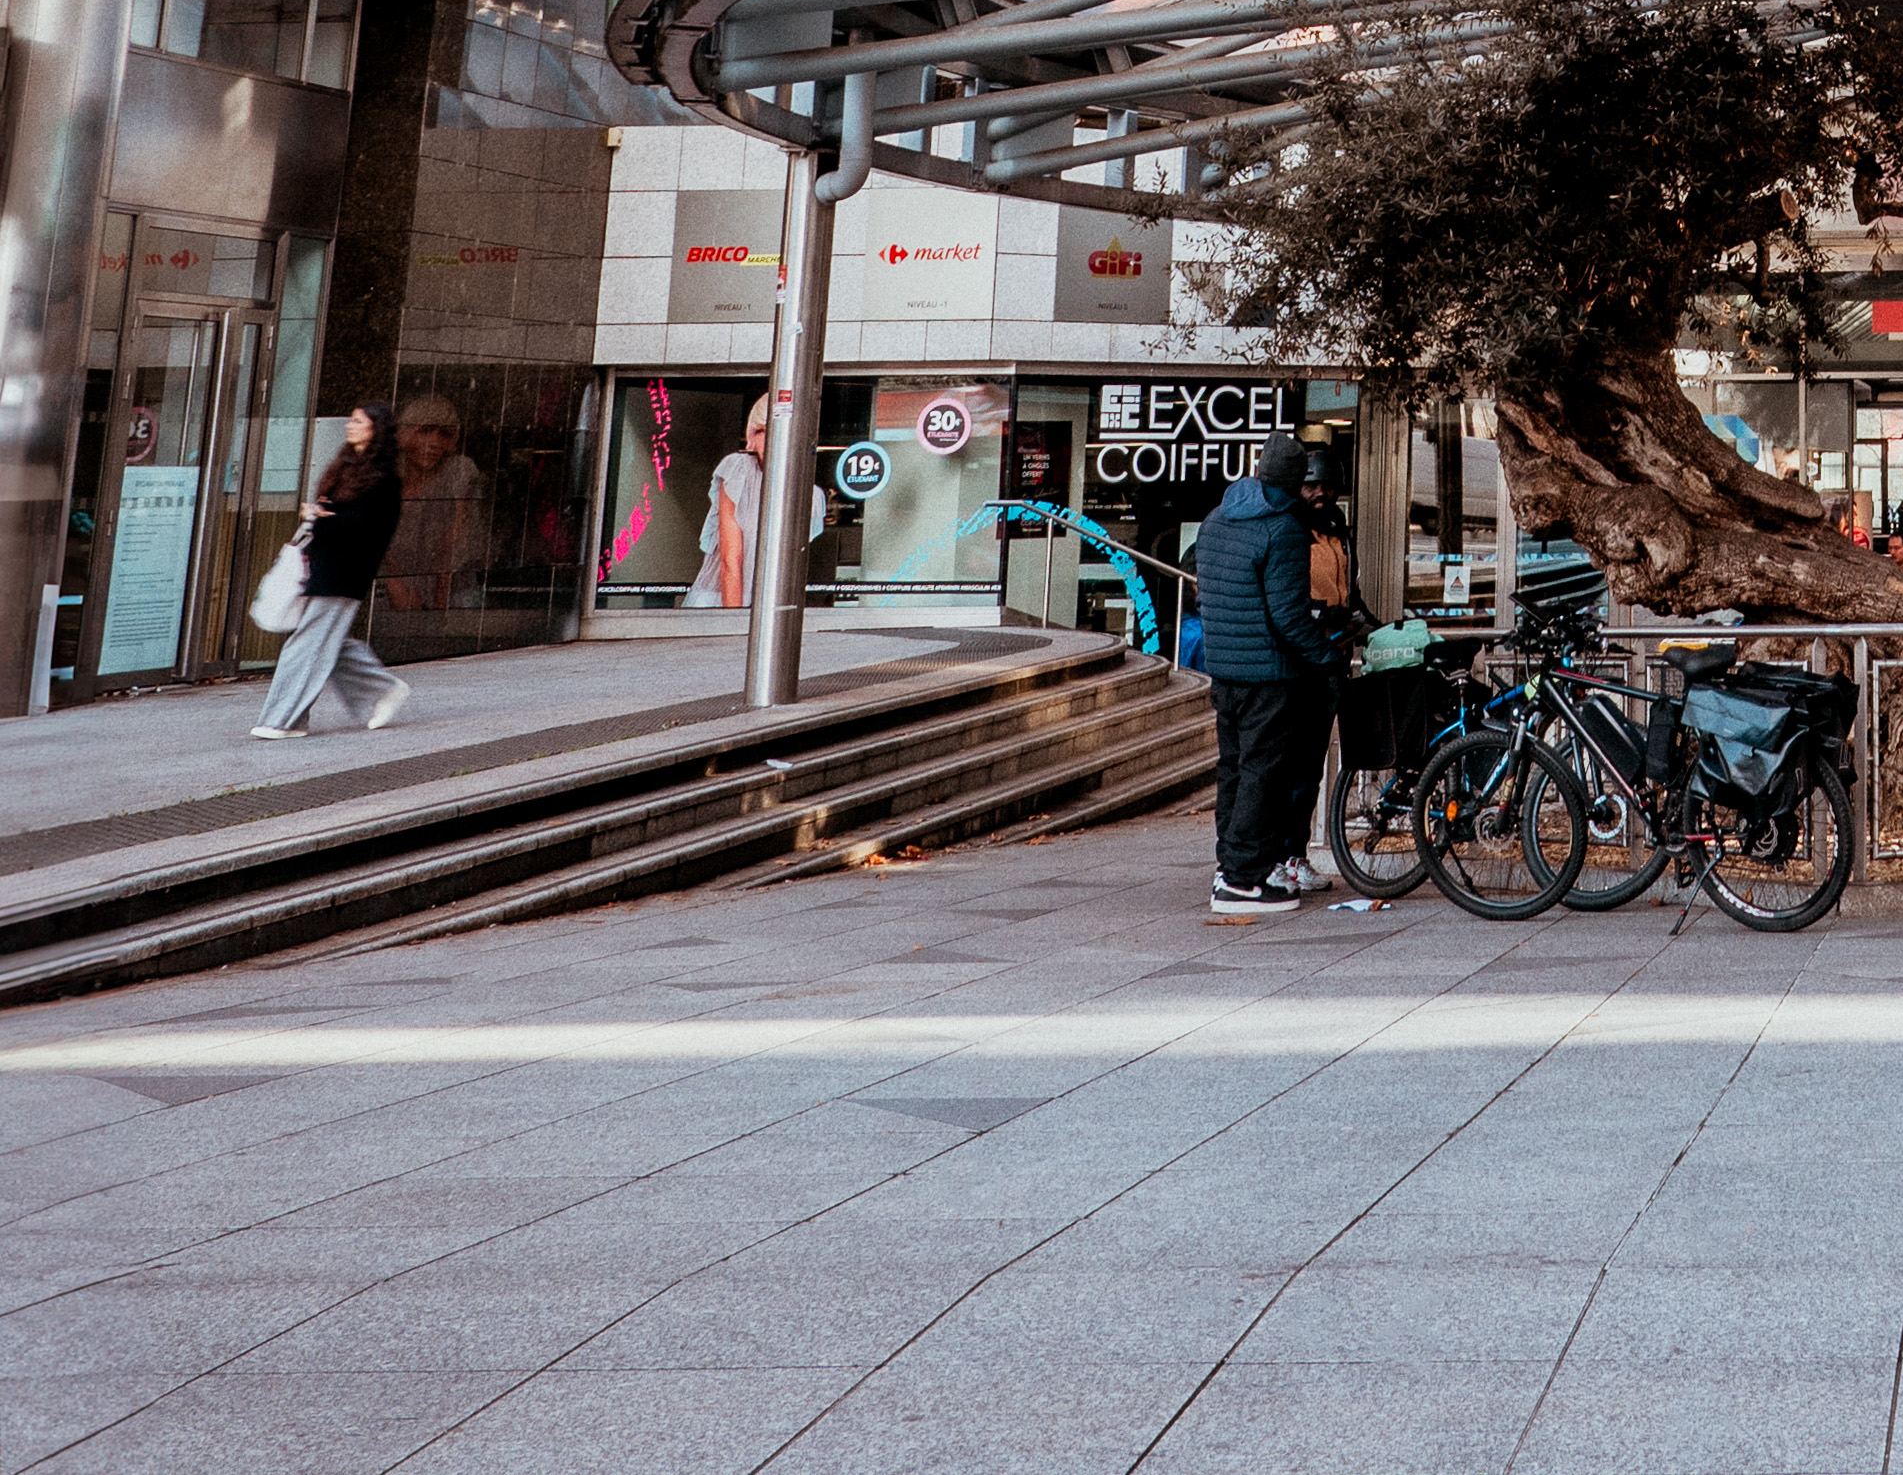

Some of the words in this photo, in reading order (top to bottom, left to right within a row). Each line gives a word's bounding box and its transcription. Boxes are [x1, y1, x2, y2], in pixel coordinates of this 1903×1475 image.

[686, 246, 749, 263] BRICO
[914, 243, 982, 262] market
[1149, 385, 1295, 437] EXCEL
[1097, 442, 1264, 483] COIFFU
